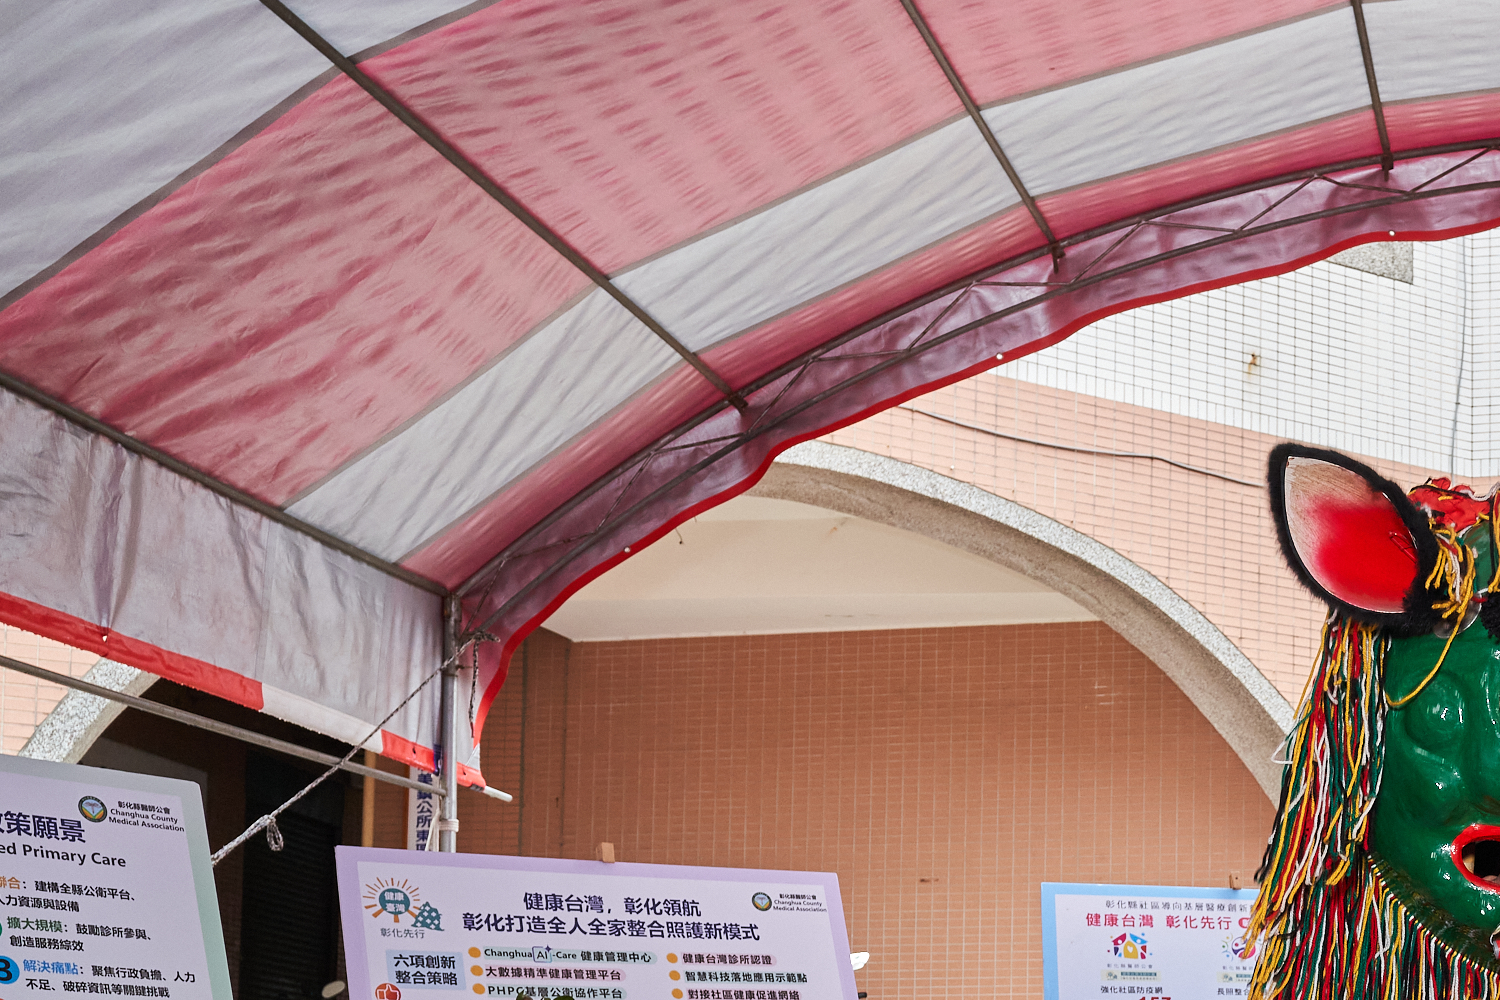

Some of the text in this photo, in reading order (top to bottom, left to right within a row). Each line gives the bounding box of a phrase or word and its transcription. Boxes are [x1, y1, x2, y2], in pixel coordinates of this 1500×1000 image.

[108, 816, 185, 833] Medical Association
[110, 808, 179, 825] Changhua County
[0, 810, 86, 843] 策願景
[22, 843, 127, 867] Primary Care
[773, 899, 823, 908] Changhua County
[462, 911, 761, 942] 彰化打造全人全家整合照護新模式
[1085, 912, 1154, 928] 健康台灣
[1165, 915, 1232, 930] 彰化先行
[380, 926, 426, 940] 彰化先行
[9, 934, 85, 952] 創造服務綜效
[393, 954, 456, 970] 六項創新
[580, 950, 652, 963] 健康管理中心
[682, 952, 773, 966] 健康台灣診所認證
[395, 969, 458, 986] 整合策略
[485, 966, 622, 982] 大數據精準健康管理平台
[684, 970, 808, 984] 智慧科技落地應用示範點
[1100, 985, 1164, 995] 強化社區防疫網
